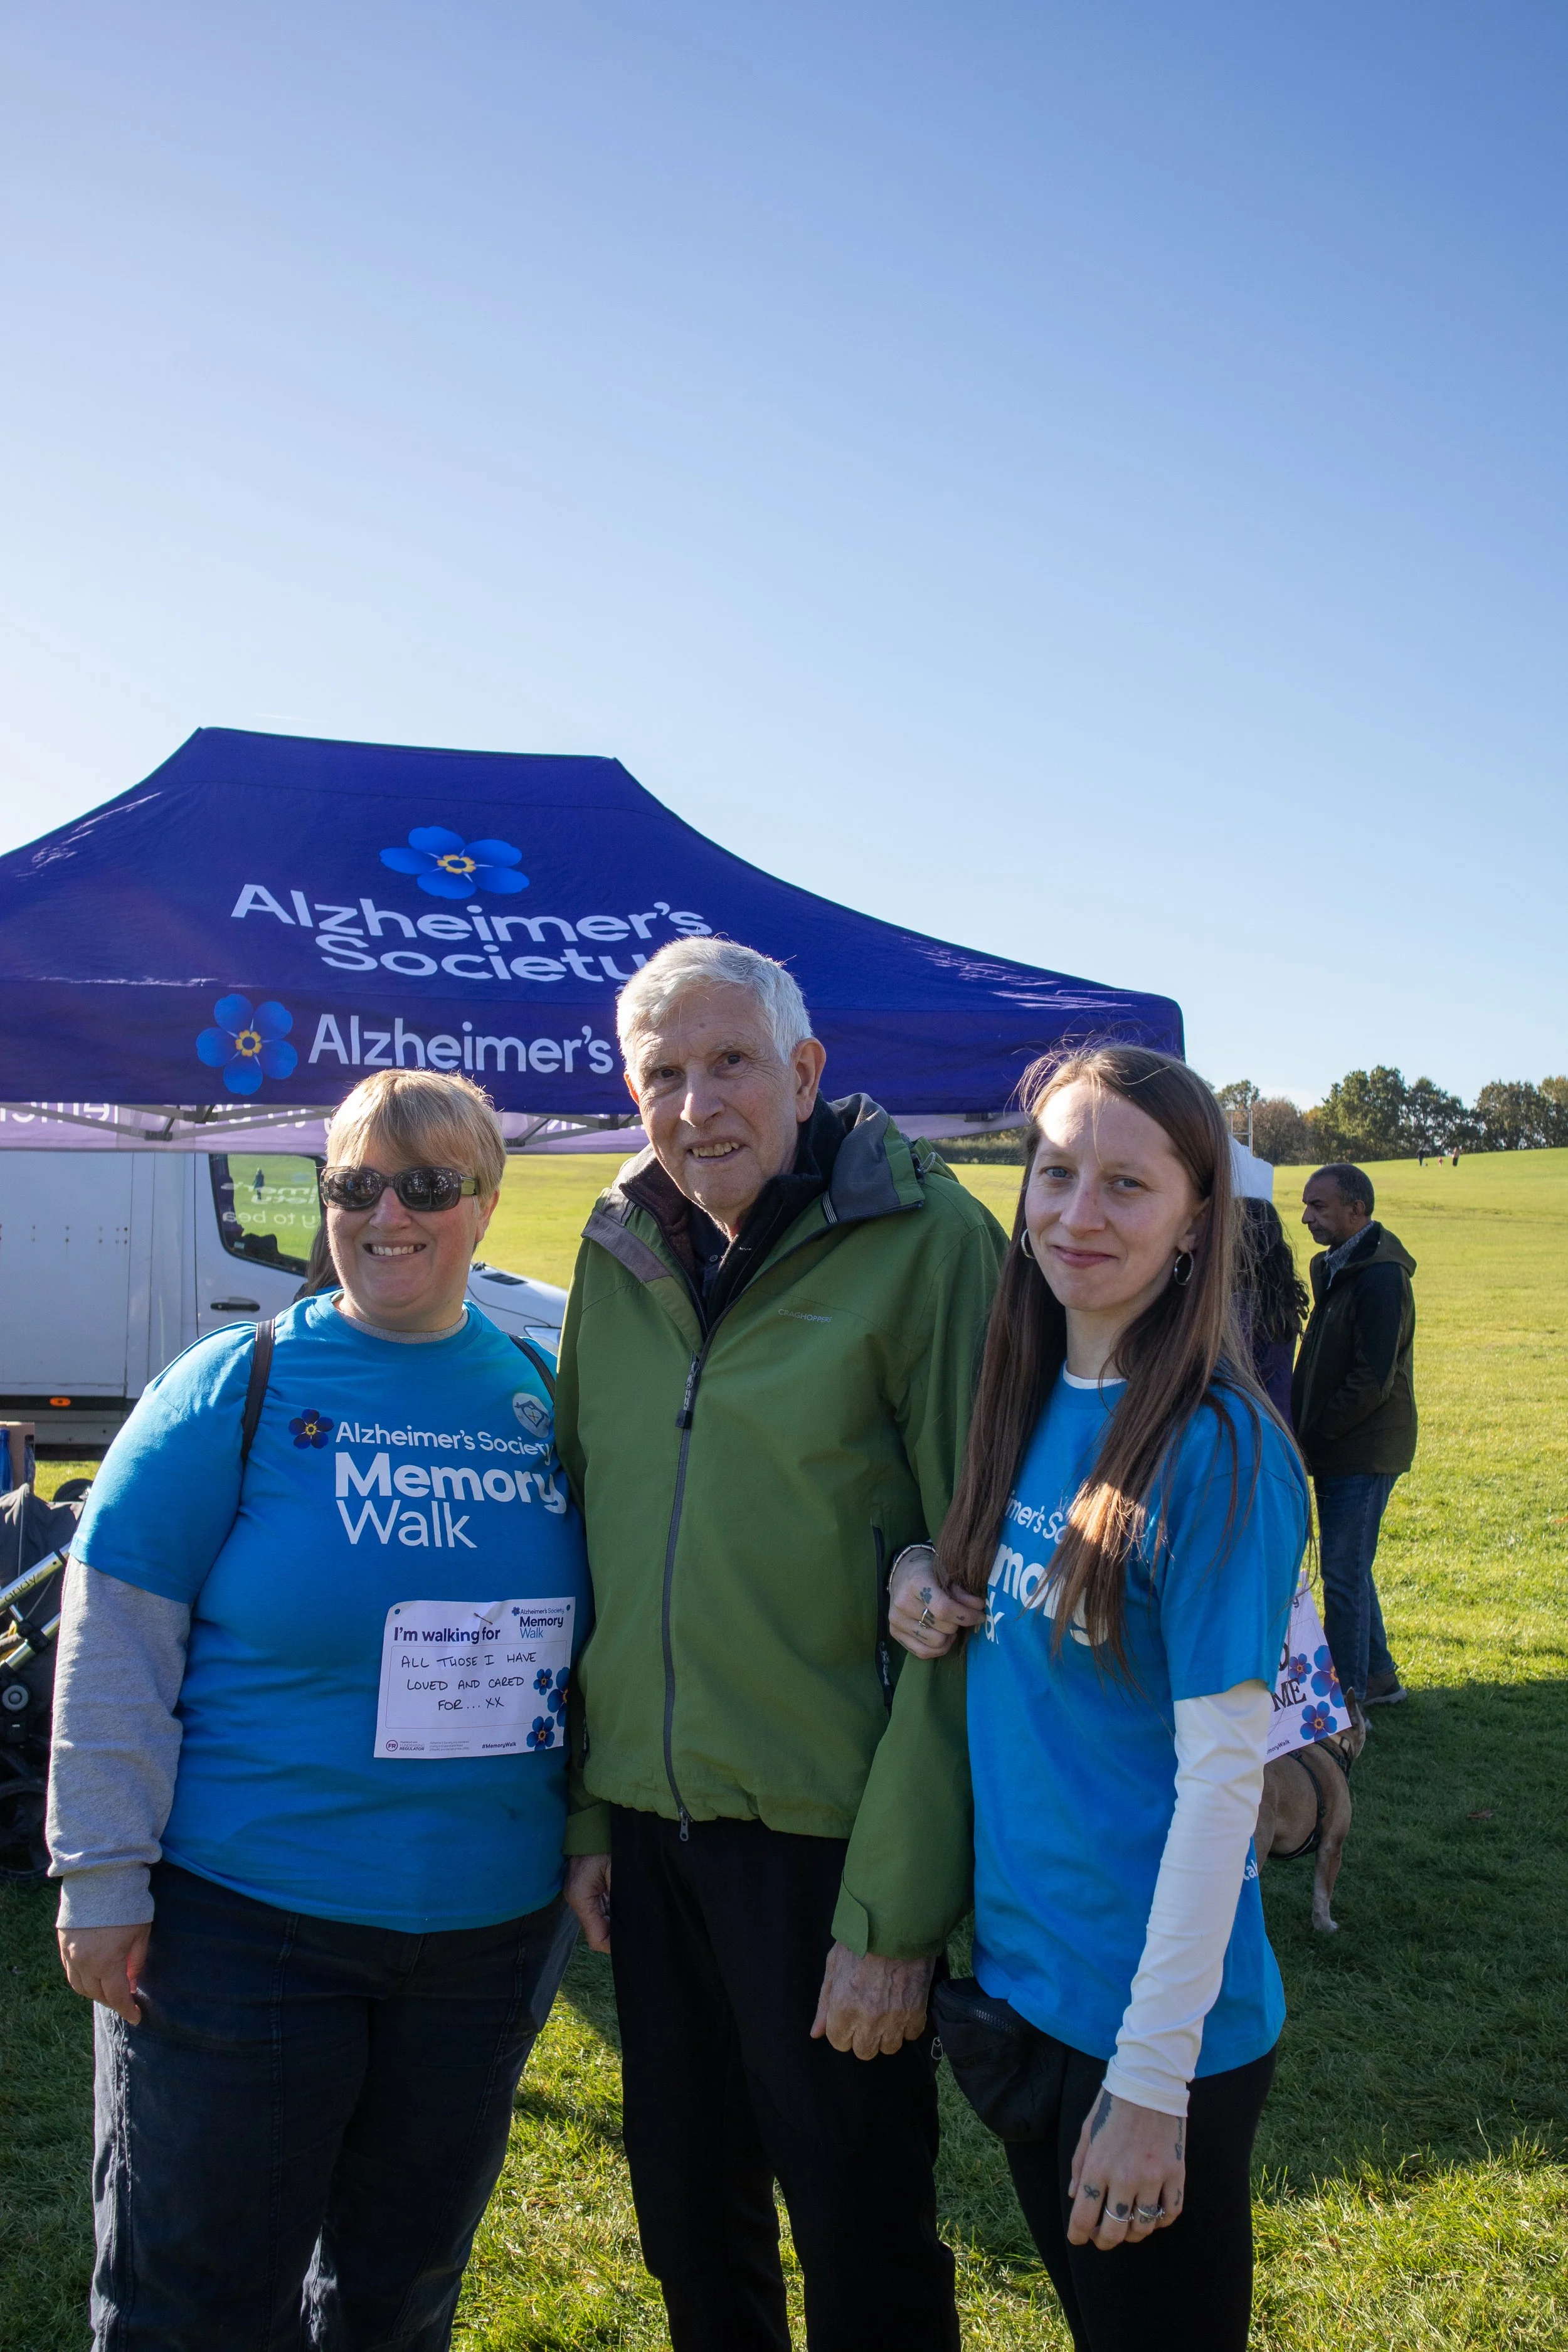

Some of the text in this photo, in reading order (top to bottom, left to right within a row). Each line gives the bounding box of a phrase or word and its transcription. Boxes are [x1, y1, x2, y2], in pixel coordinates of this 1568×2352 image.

[231, 884, 712, 942] Alzheimer's
[308, 1014, 613, 1074] Alzheimer's
[778, 1308, 833, 1323] CRAGHOPPERS
[336, 1421, 554, 1466] Alzheimer's Society
[335, 1452, 567, 1514] Memory
[336, 1499, 477, 1549] Walk
[520, 1616, 564, 1628] Memory
[394, 1626, 501, 1645] I'm walking for
[520, 1627, 544, 1639] Walk
[401, 1652, 537, 1668] ALL THOSE I HAVE
[407, 1677, 524, 1691] LOVED AND CARED
